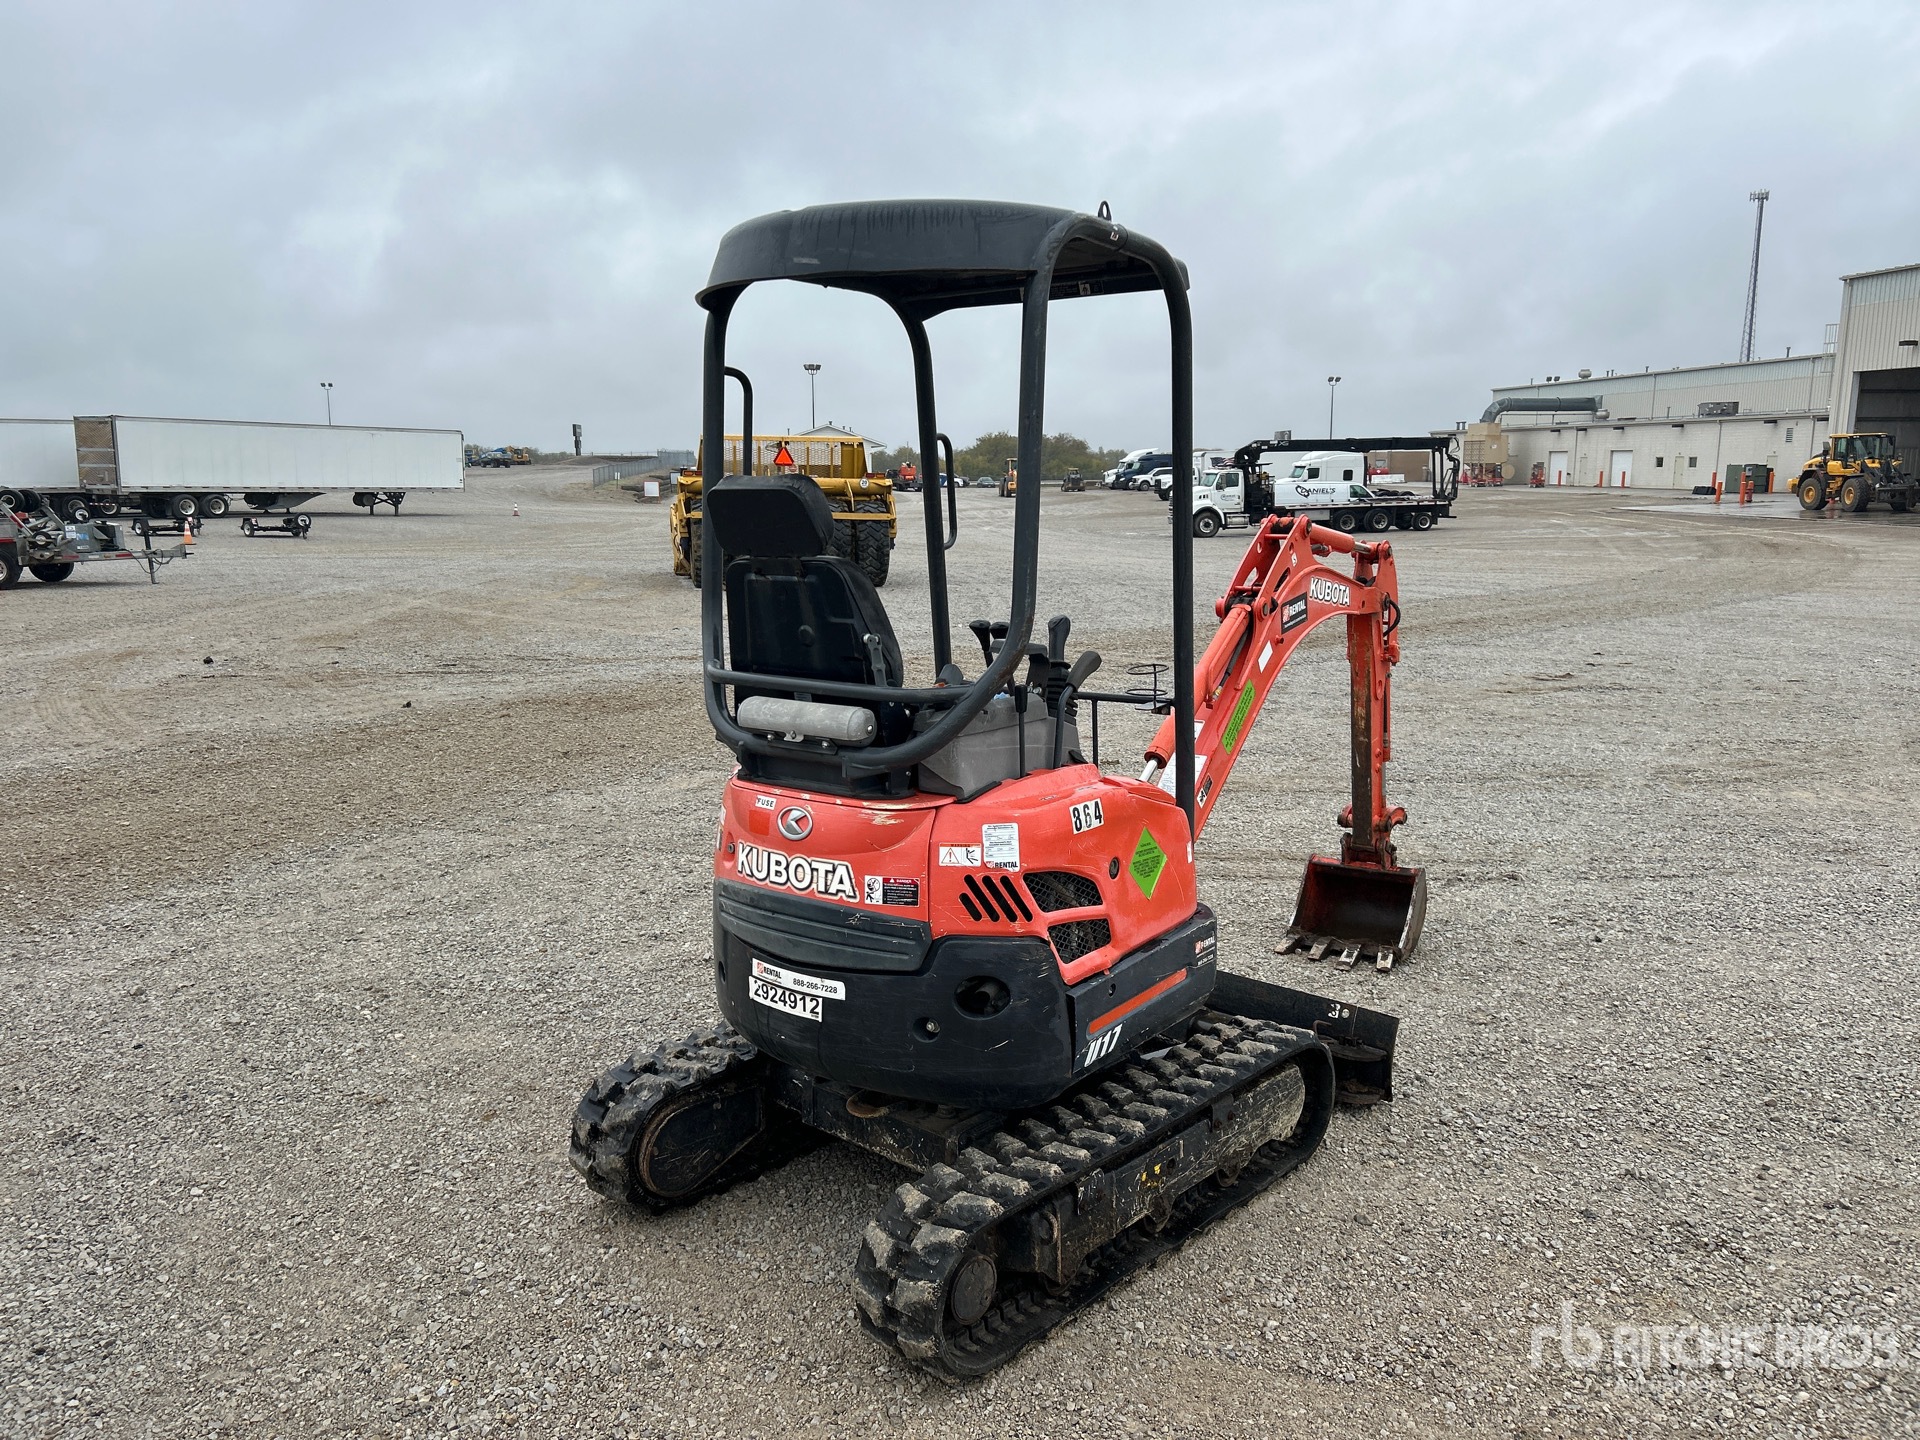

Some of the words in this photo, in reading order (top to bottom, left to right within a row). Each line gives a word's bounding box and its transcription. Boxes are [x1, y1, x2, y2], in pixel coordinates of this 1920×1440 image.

[1309, 577, 1351, 607] KUBOTA
[1289, 599, 1307, 617] RENTAL
[757, 797, 775, 808] FUSE
[1072, 800, 1103, 832] 864
[737, 842, 858, 899] KUBOTA
[994, 861, 1019, 869] RENTAL
[763, 966, 782, 979] RENTAL
[753, 981, 820, 1015] 2924912
